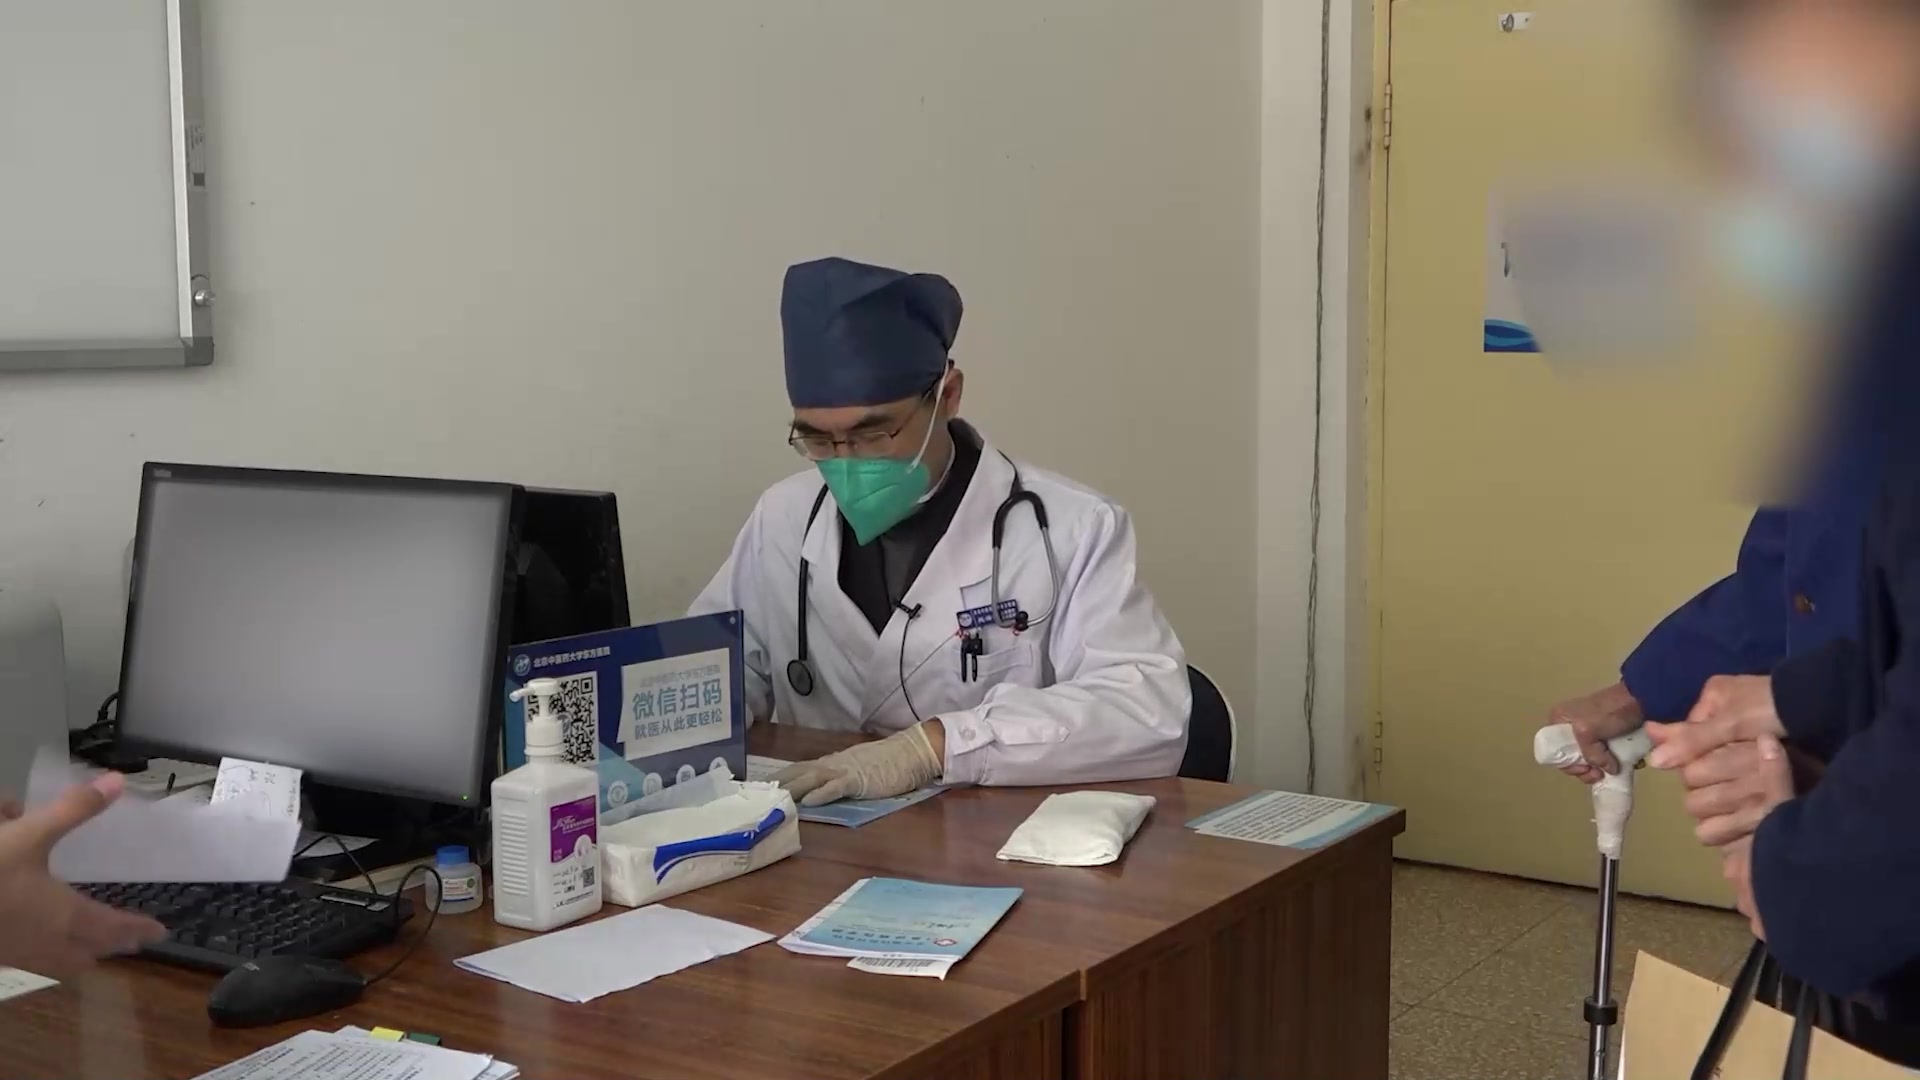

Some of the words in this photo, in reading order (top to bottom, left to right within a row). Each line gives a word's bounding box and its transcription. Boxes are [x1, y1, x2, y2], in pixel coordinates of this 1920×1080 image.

[632, 678, 722, 721] 微信扫码
[634, 707, 723, 740] 就医从此更轻松
